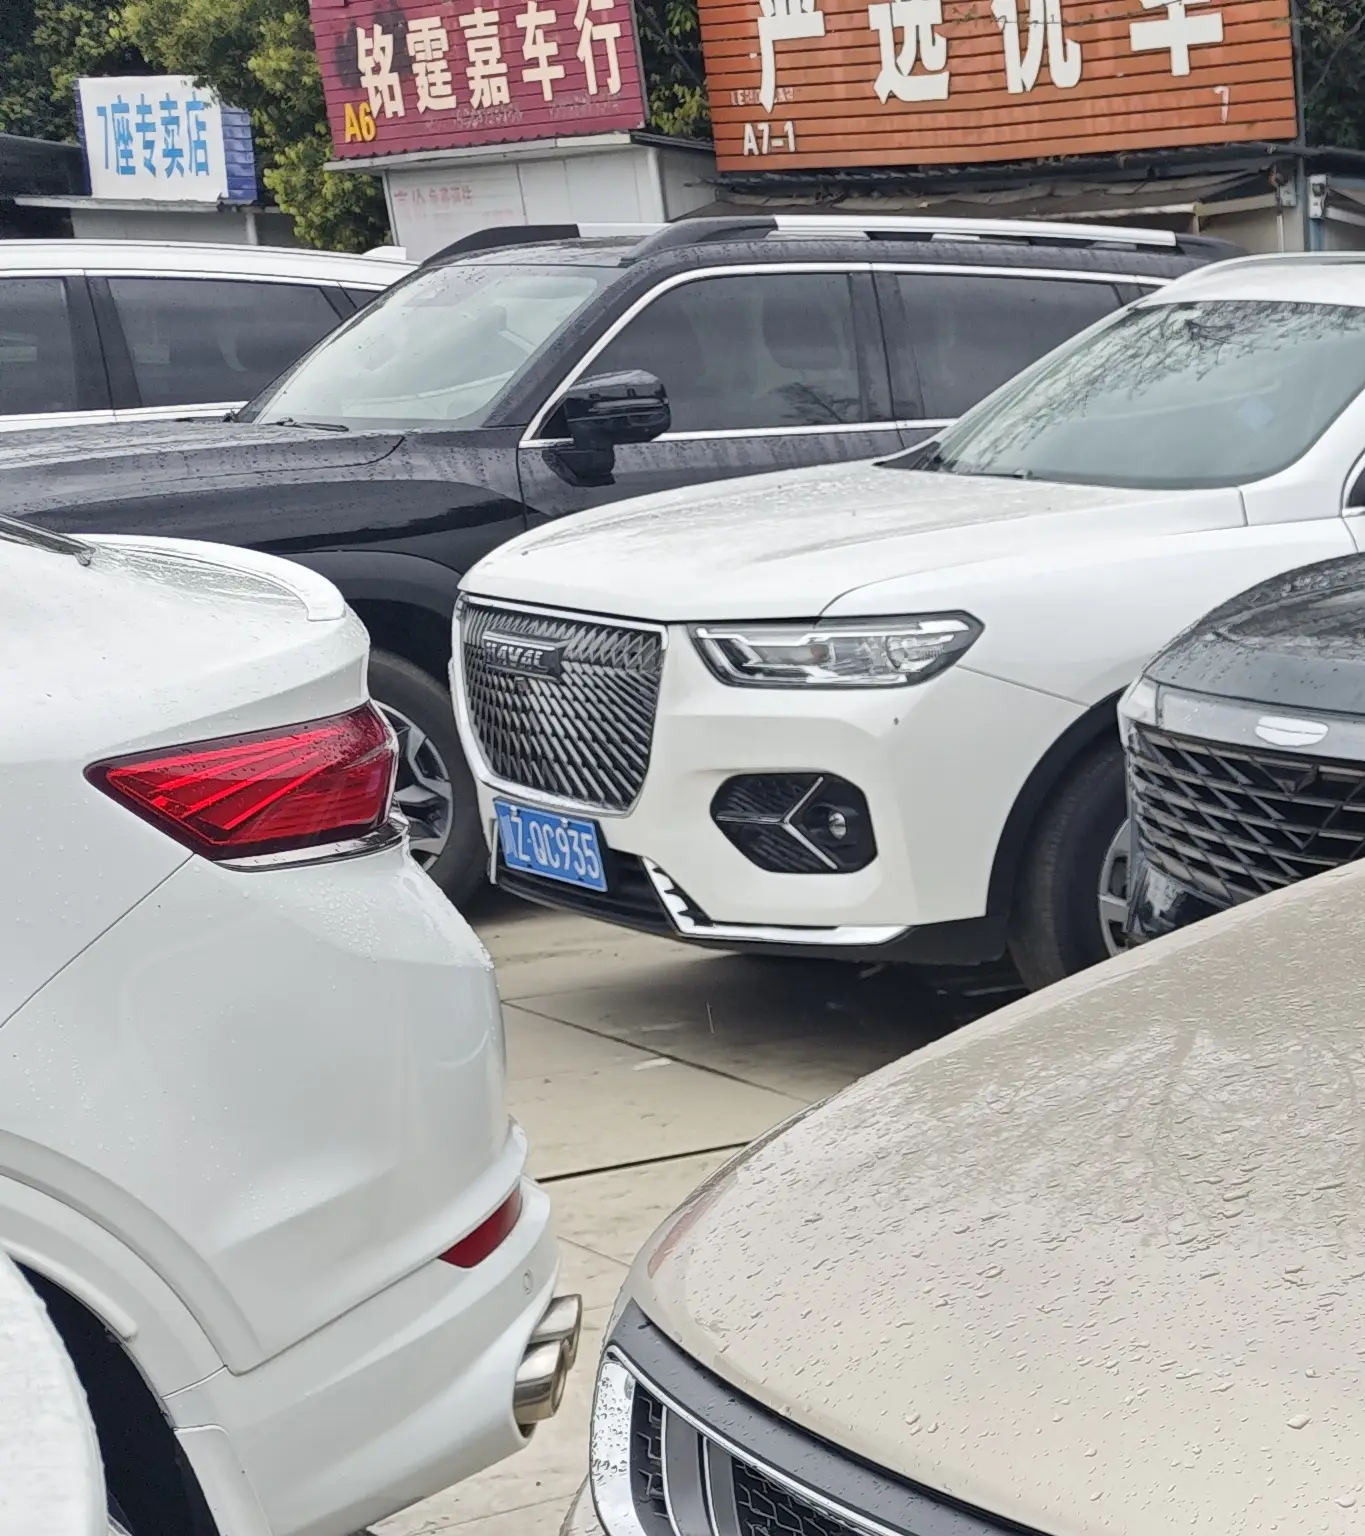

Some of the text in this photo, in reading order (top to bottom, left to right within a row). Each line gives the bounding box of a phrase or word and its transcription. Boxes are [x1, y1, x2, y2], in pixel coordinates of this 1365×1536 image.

[356, 0, 622, 119] 铭霆嘉车行
[96, 91, 210, 178] 7座专卖店
[344, 102, 377, 143] A6
[743, 120, 796, 156] A7-1
